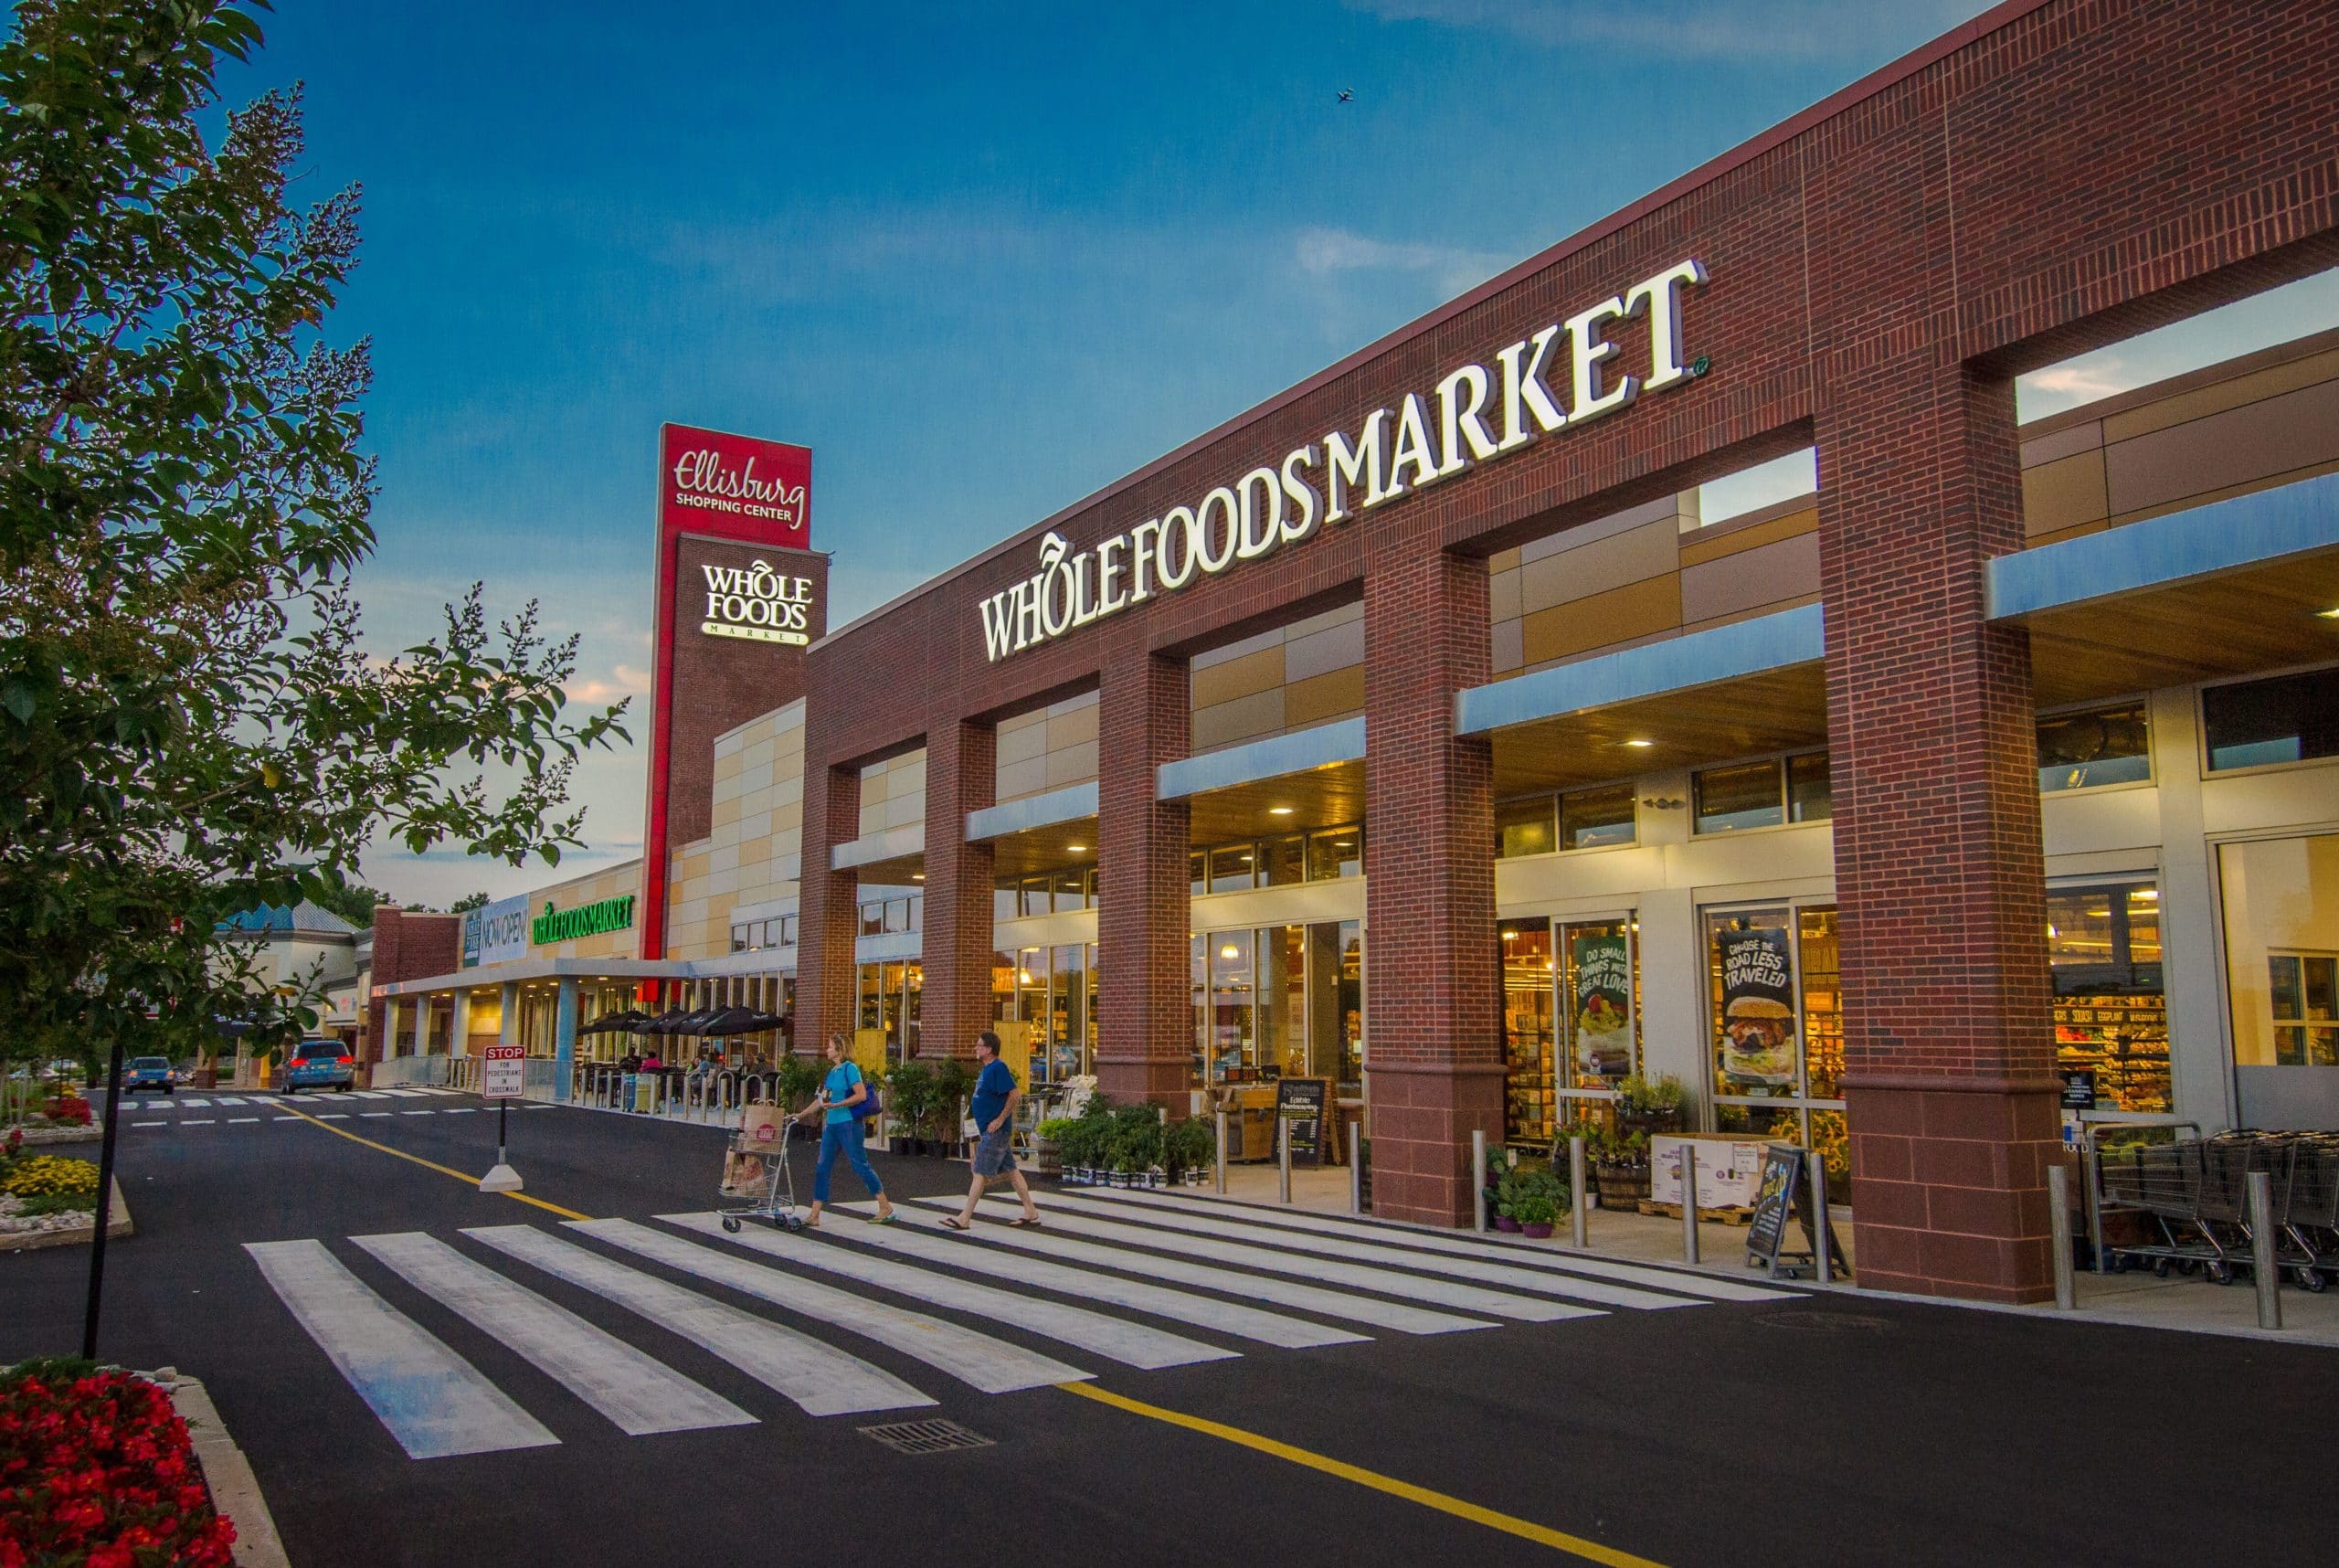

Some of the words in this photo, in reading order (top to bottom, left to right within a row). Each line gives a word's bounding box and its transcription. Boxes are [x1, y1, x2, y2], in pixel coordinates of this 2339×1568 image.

[979, 532, 1131, 662] WHOLE
[1131, 444, 1323, 604] FOODS
[1323, 259, 1709, 524] MARKET
[673, 450, 805, 530] Ellisburg
[676, 493, 741, 513] SHOPPING
[744, 504, 791, 522] CENTER
[702, 559, 812, 603] WHOLE
[706, 592, 807, 630] FOODS
[711, 625, 800, 642] MARKET
[533, 901, 561, 945] WHOLE
[561, 907, 588, 940] FOODS
[588, 895, 633, 934] MARKET
[482, 917, 502, 949] NOW
[1586, 949, 1598, 962] DO
[1600, 948, 1625, 961] SMALL
[1729, 939, 1760, 956] CHOOSE
[1762, 942, 1775, 952] THE
[1579, 959, 1610, 980] THINGS
[1726, 953, 1751, 971] ROAD
[1752, 951, 1783, 971] LESS
[1578, 973, 1602, 998] GREAT
[1603, 973, 1628, 995] LOVE
[1724, 967, 1786, 991] TRAVELED
[488, 1048, 523, 1059] STOP
[489, 1086, 519, 1094] CROSSWALK
